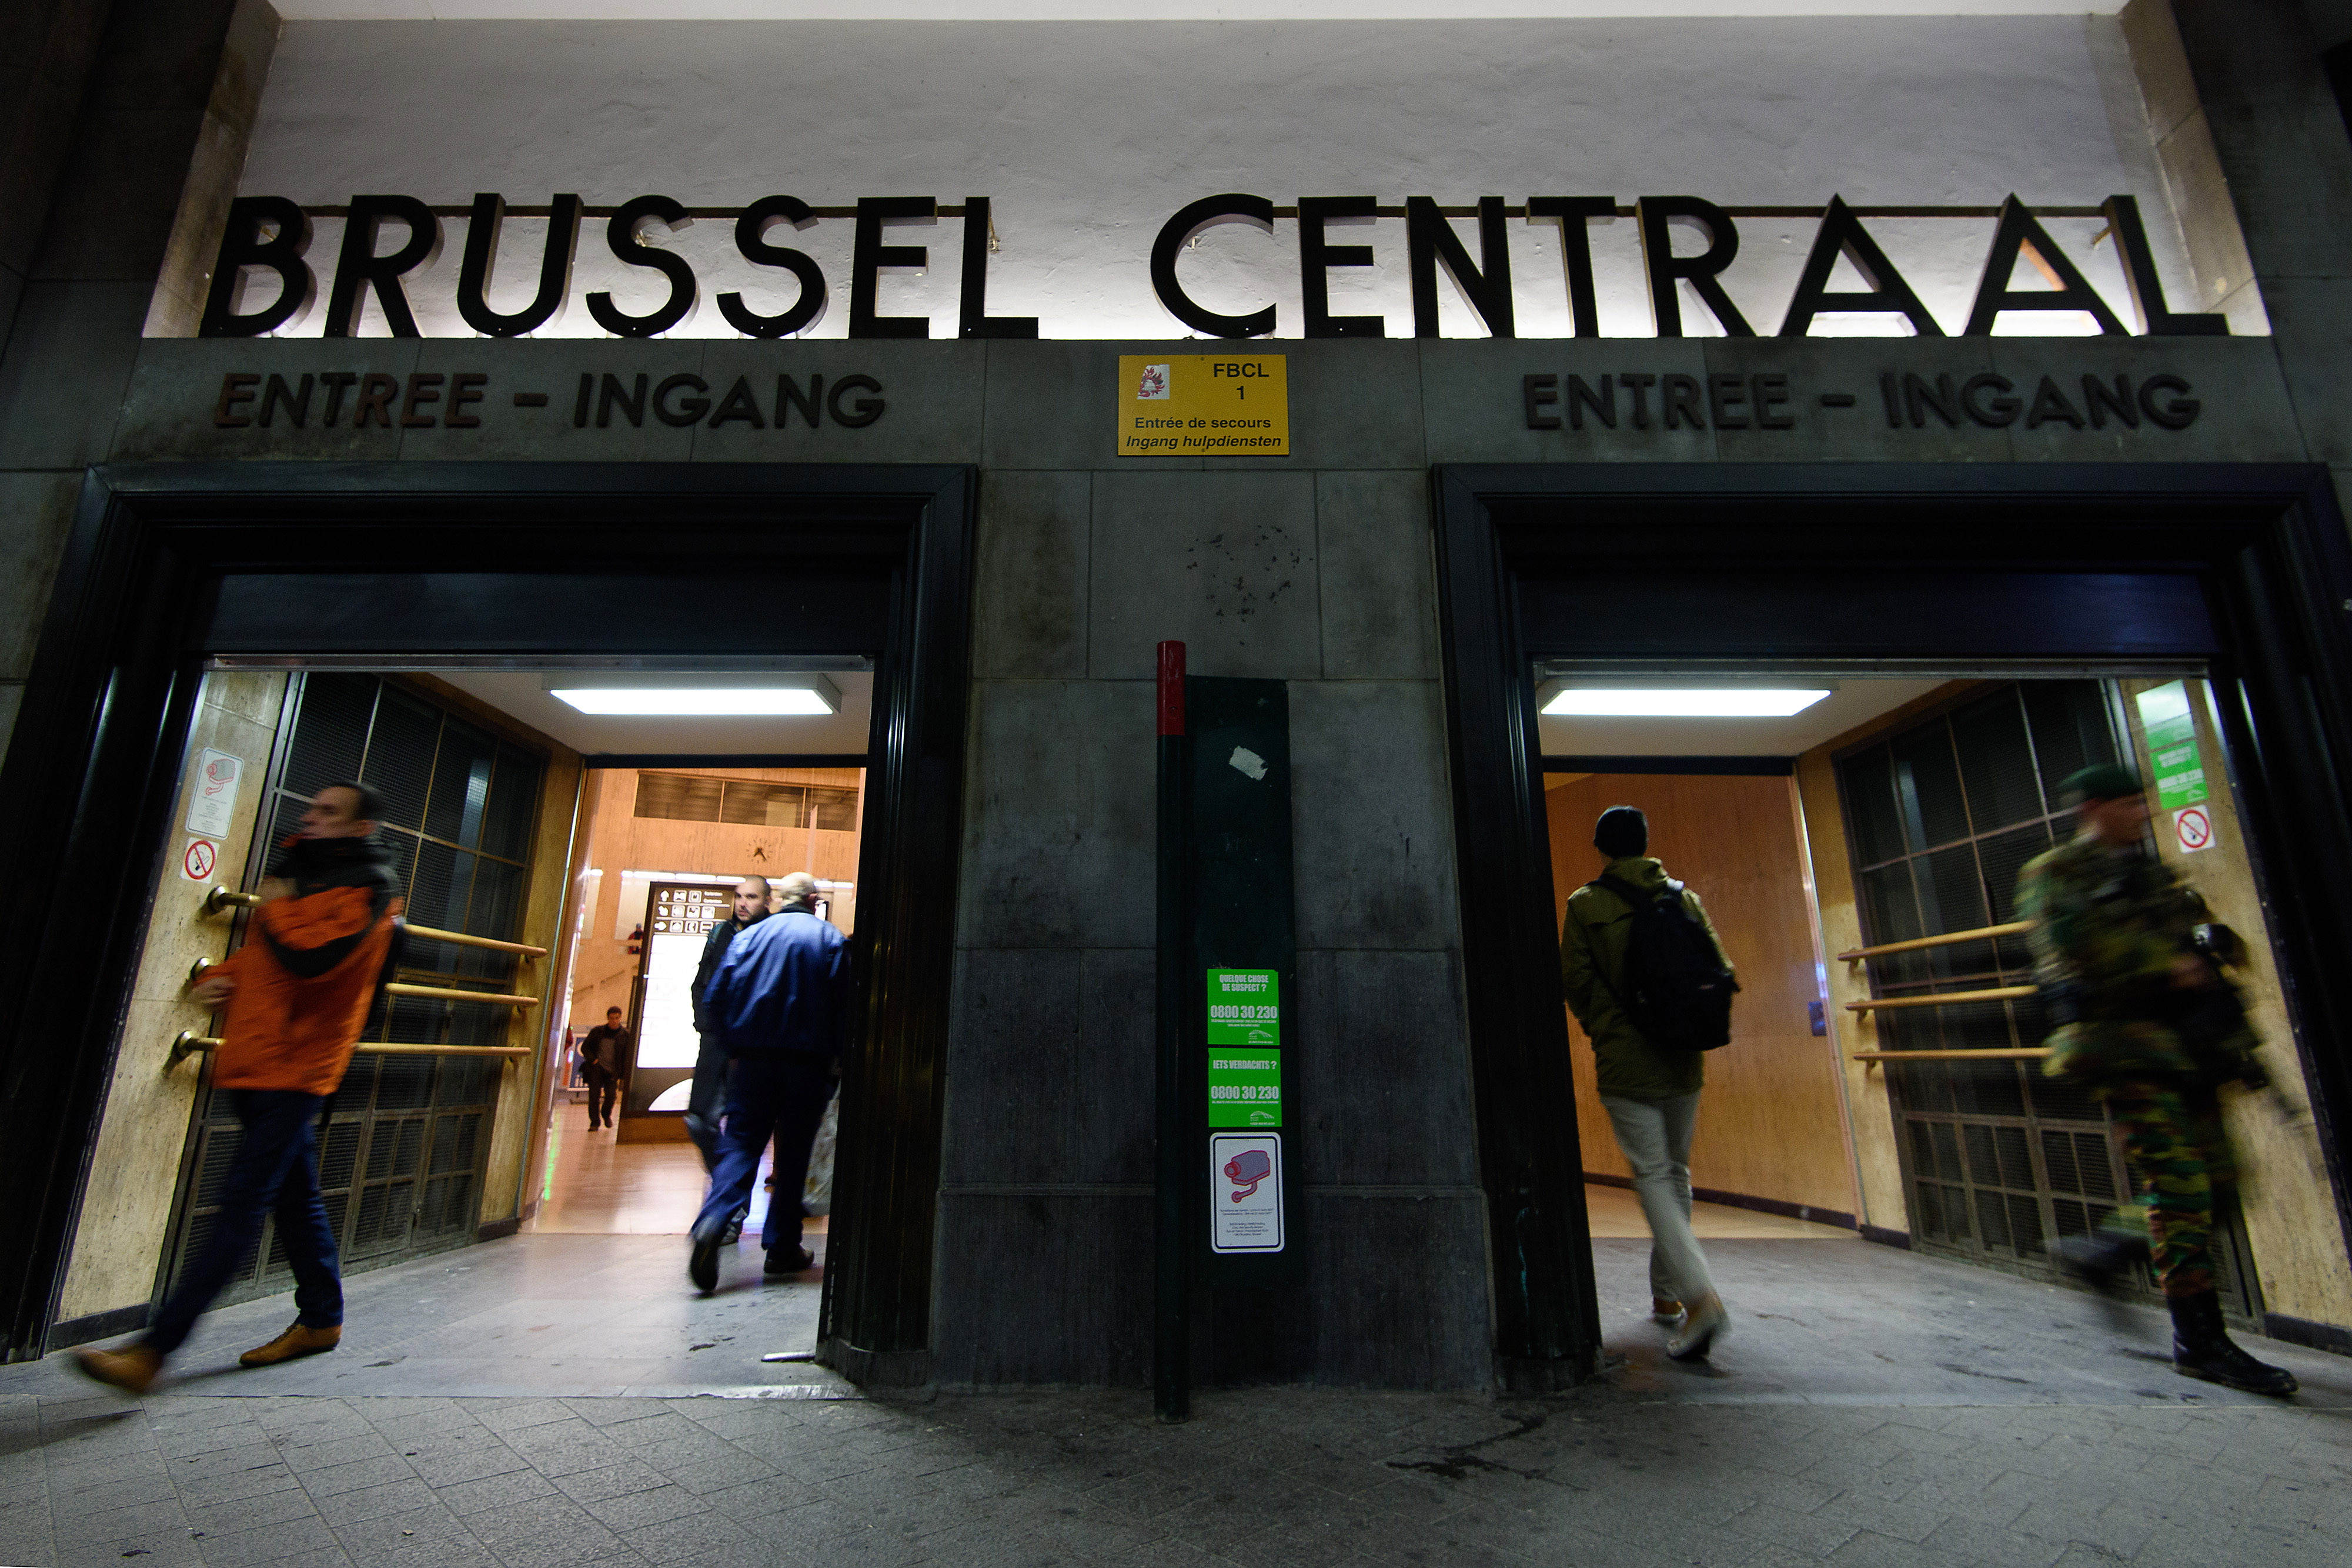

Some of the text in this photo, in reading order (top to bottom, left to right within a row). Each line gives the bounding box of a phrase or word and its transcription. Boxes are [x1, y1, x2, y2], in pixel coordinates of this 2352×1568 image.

[198, 193, 2230, 339] BRUSSEL CENTRAAL
[1213, 363, 1269, 378] FBCL
[1236, 386, 1245, 400] 1
[212, 372, 886, 429] ENTREE - INGANG
[1523, 372, 2201, 430] ENTREE - INGANG
[1135, 416, 1271, 429] Entrée de secours
[1126, 435, 1281, 450] Ingang hulpdiensten
[1220, 974, 1247, 983] QUELQUE
[1211, 1005, 1278, 1019] 0800 30 230
[1213, 1060, 1277, 1069] IETS VERDACHTS ?
[1211, 1085, 1279, 1099] 0800 30 230
